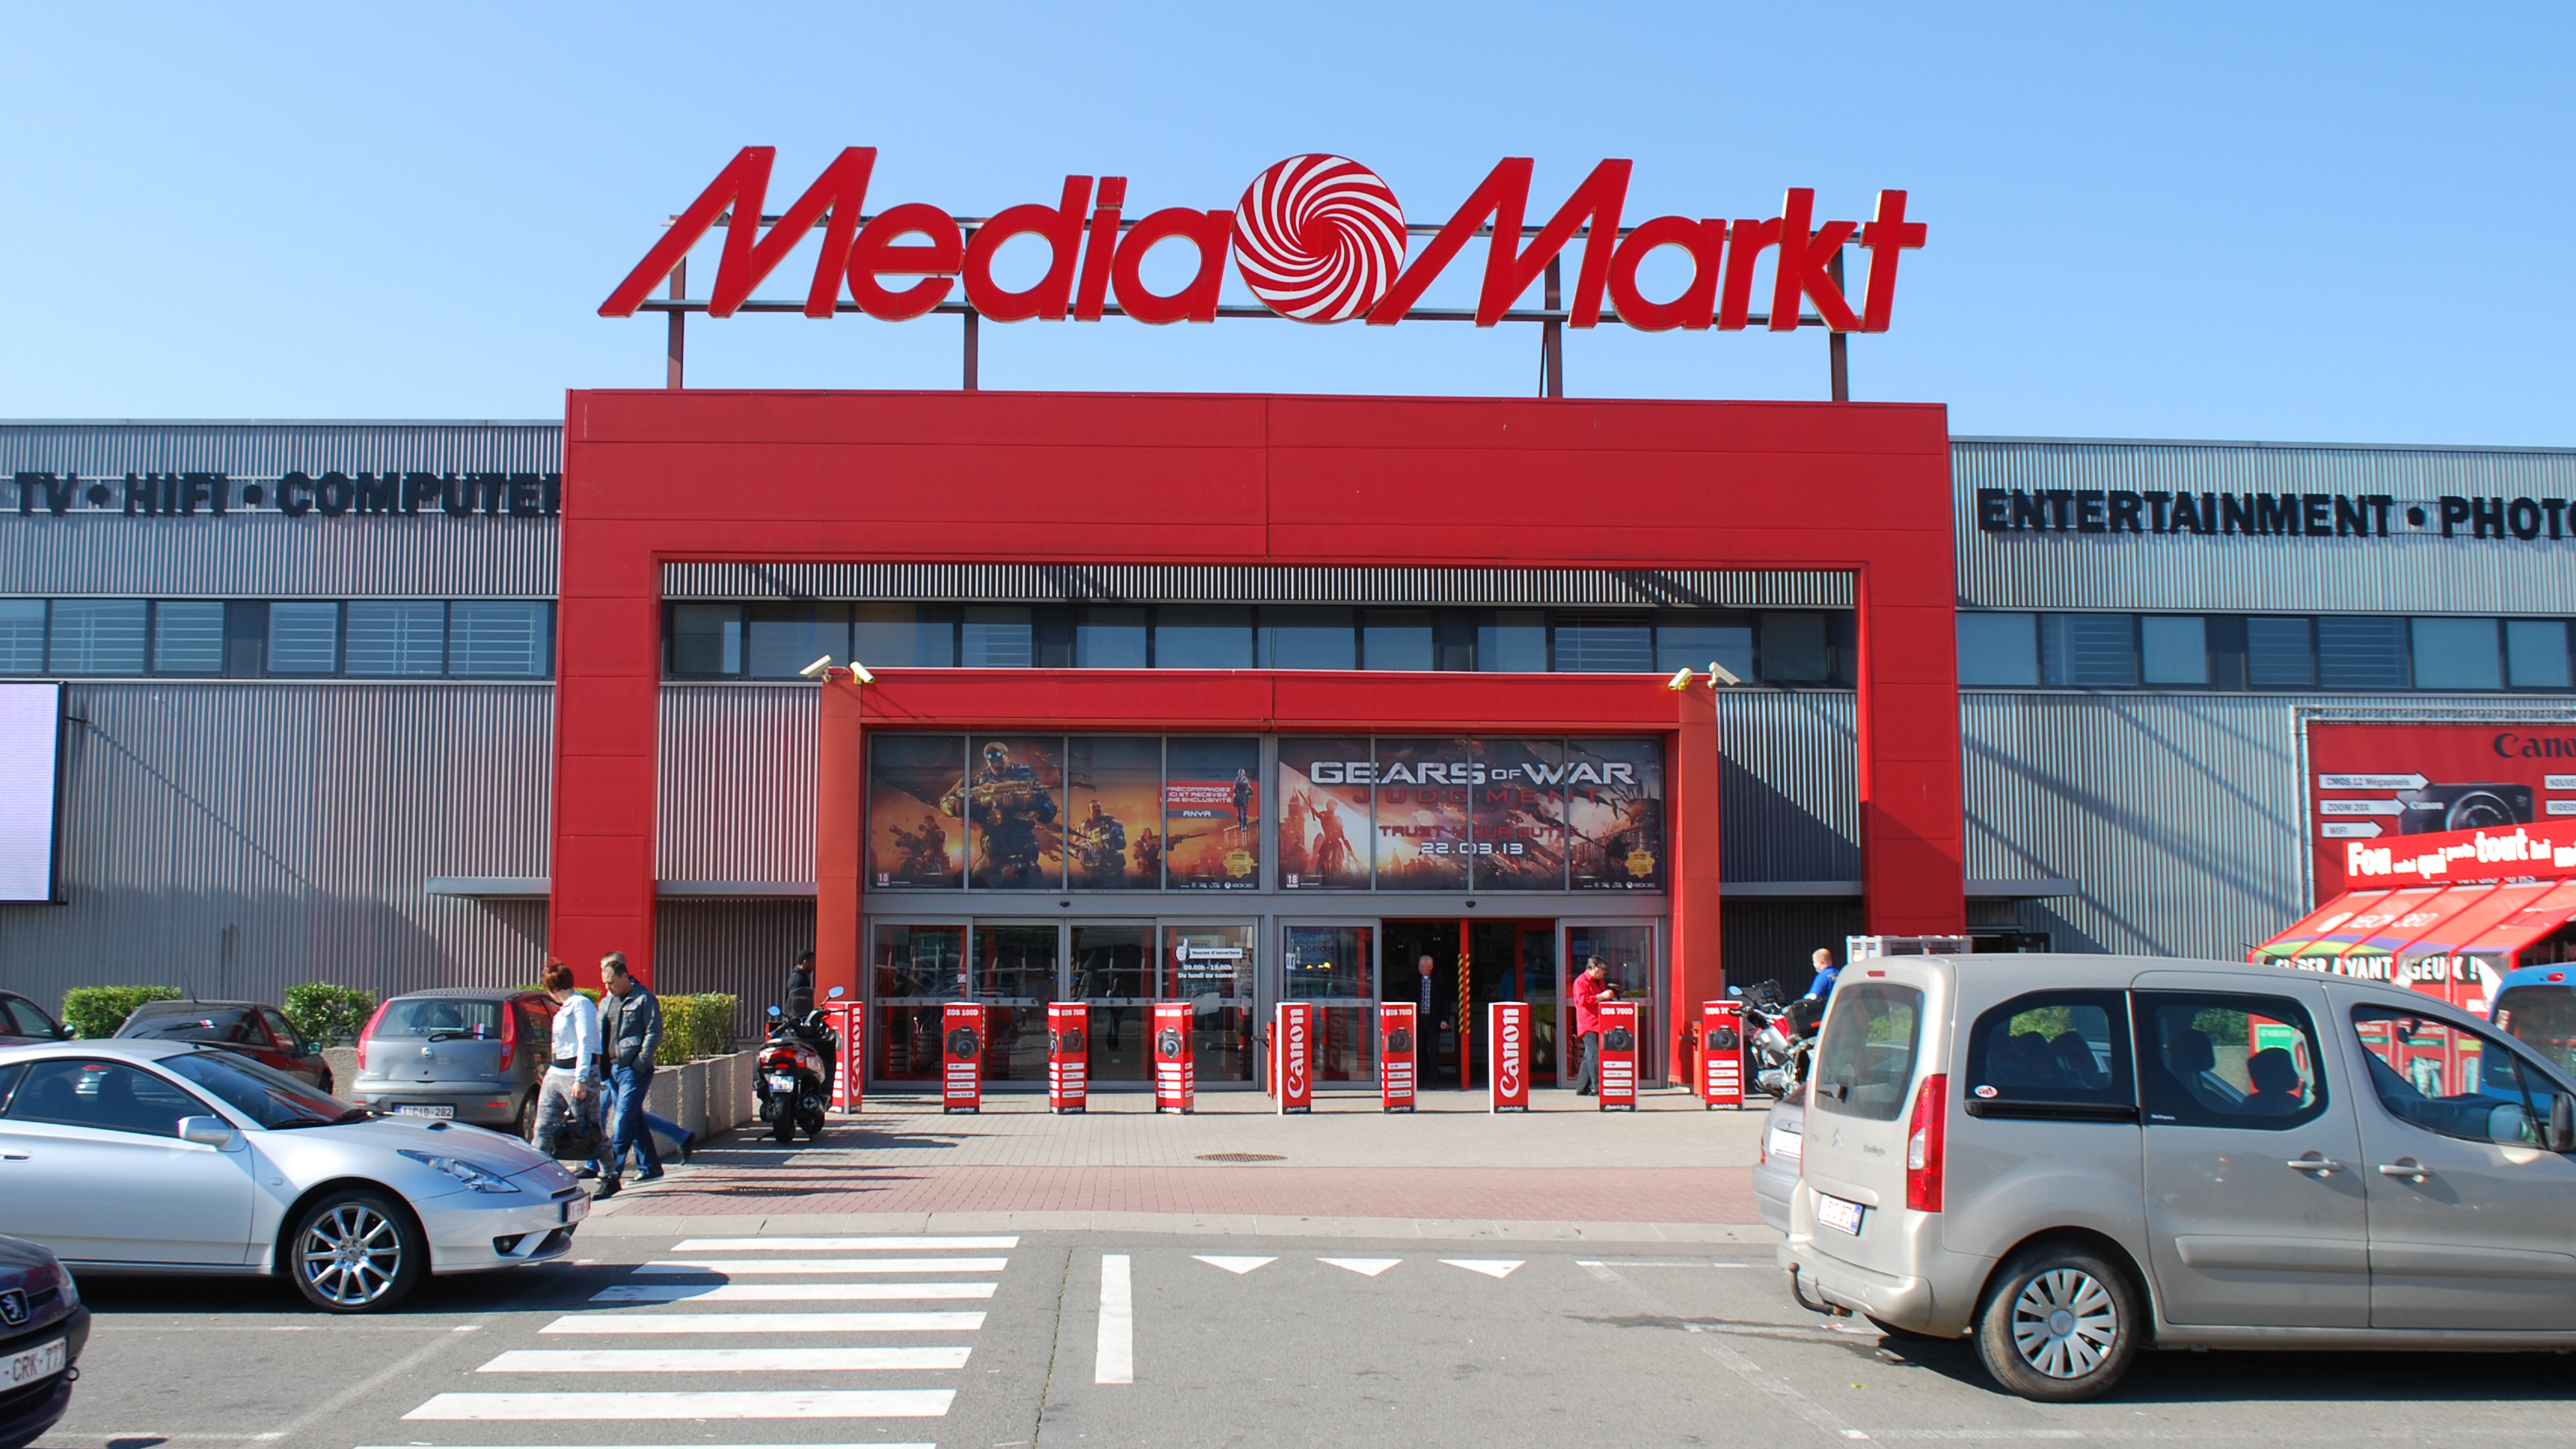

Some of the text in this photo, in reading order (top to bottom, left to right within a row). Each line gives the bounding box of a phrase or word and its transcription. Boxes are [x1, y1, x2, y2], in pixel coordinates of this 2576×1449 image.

[597, 146, 1928, 333] Media Markt
[14, 472, 78, 517] TV
[124, 472, 228, 517] HIFI
[1977, 488, 2576, 541] ENTERTAINMENT PHOT
[1310, 761, 1637, 785] GEARS OF WAR
[1353, 788, 1603, 804] JUDGMENT
[1378, 826, 1441, 838] TRUST
[1452, 826, 1511, 838] YOUR
[1420, 842, 1524, 856] 22.03.13
[2348, 841, 2392, 877] Fou
[2474, 827, 2529, 863] tout
[878, 873, 889, 882] 18
[1288, 875, 1298, 884] 18
[2332, 955, 2465, 980] AVANTGEUX
[1705, 1006, 1720, 1015] EOS
[851, 1007, 861, 1097] Canon
[1288, 1008, 1304, 1098] Canon
[1499, 1008, 1520, 1098] Canon
